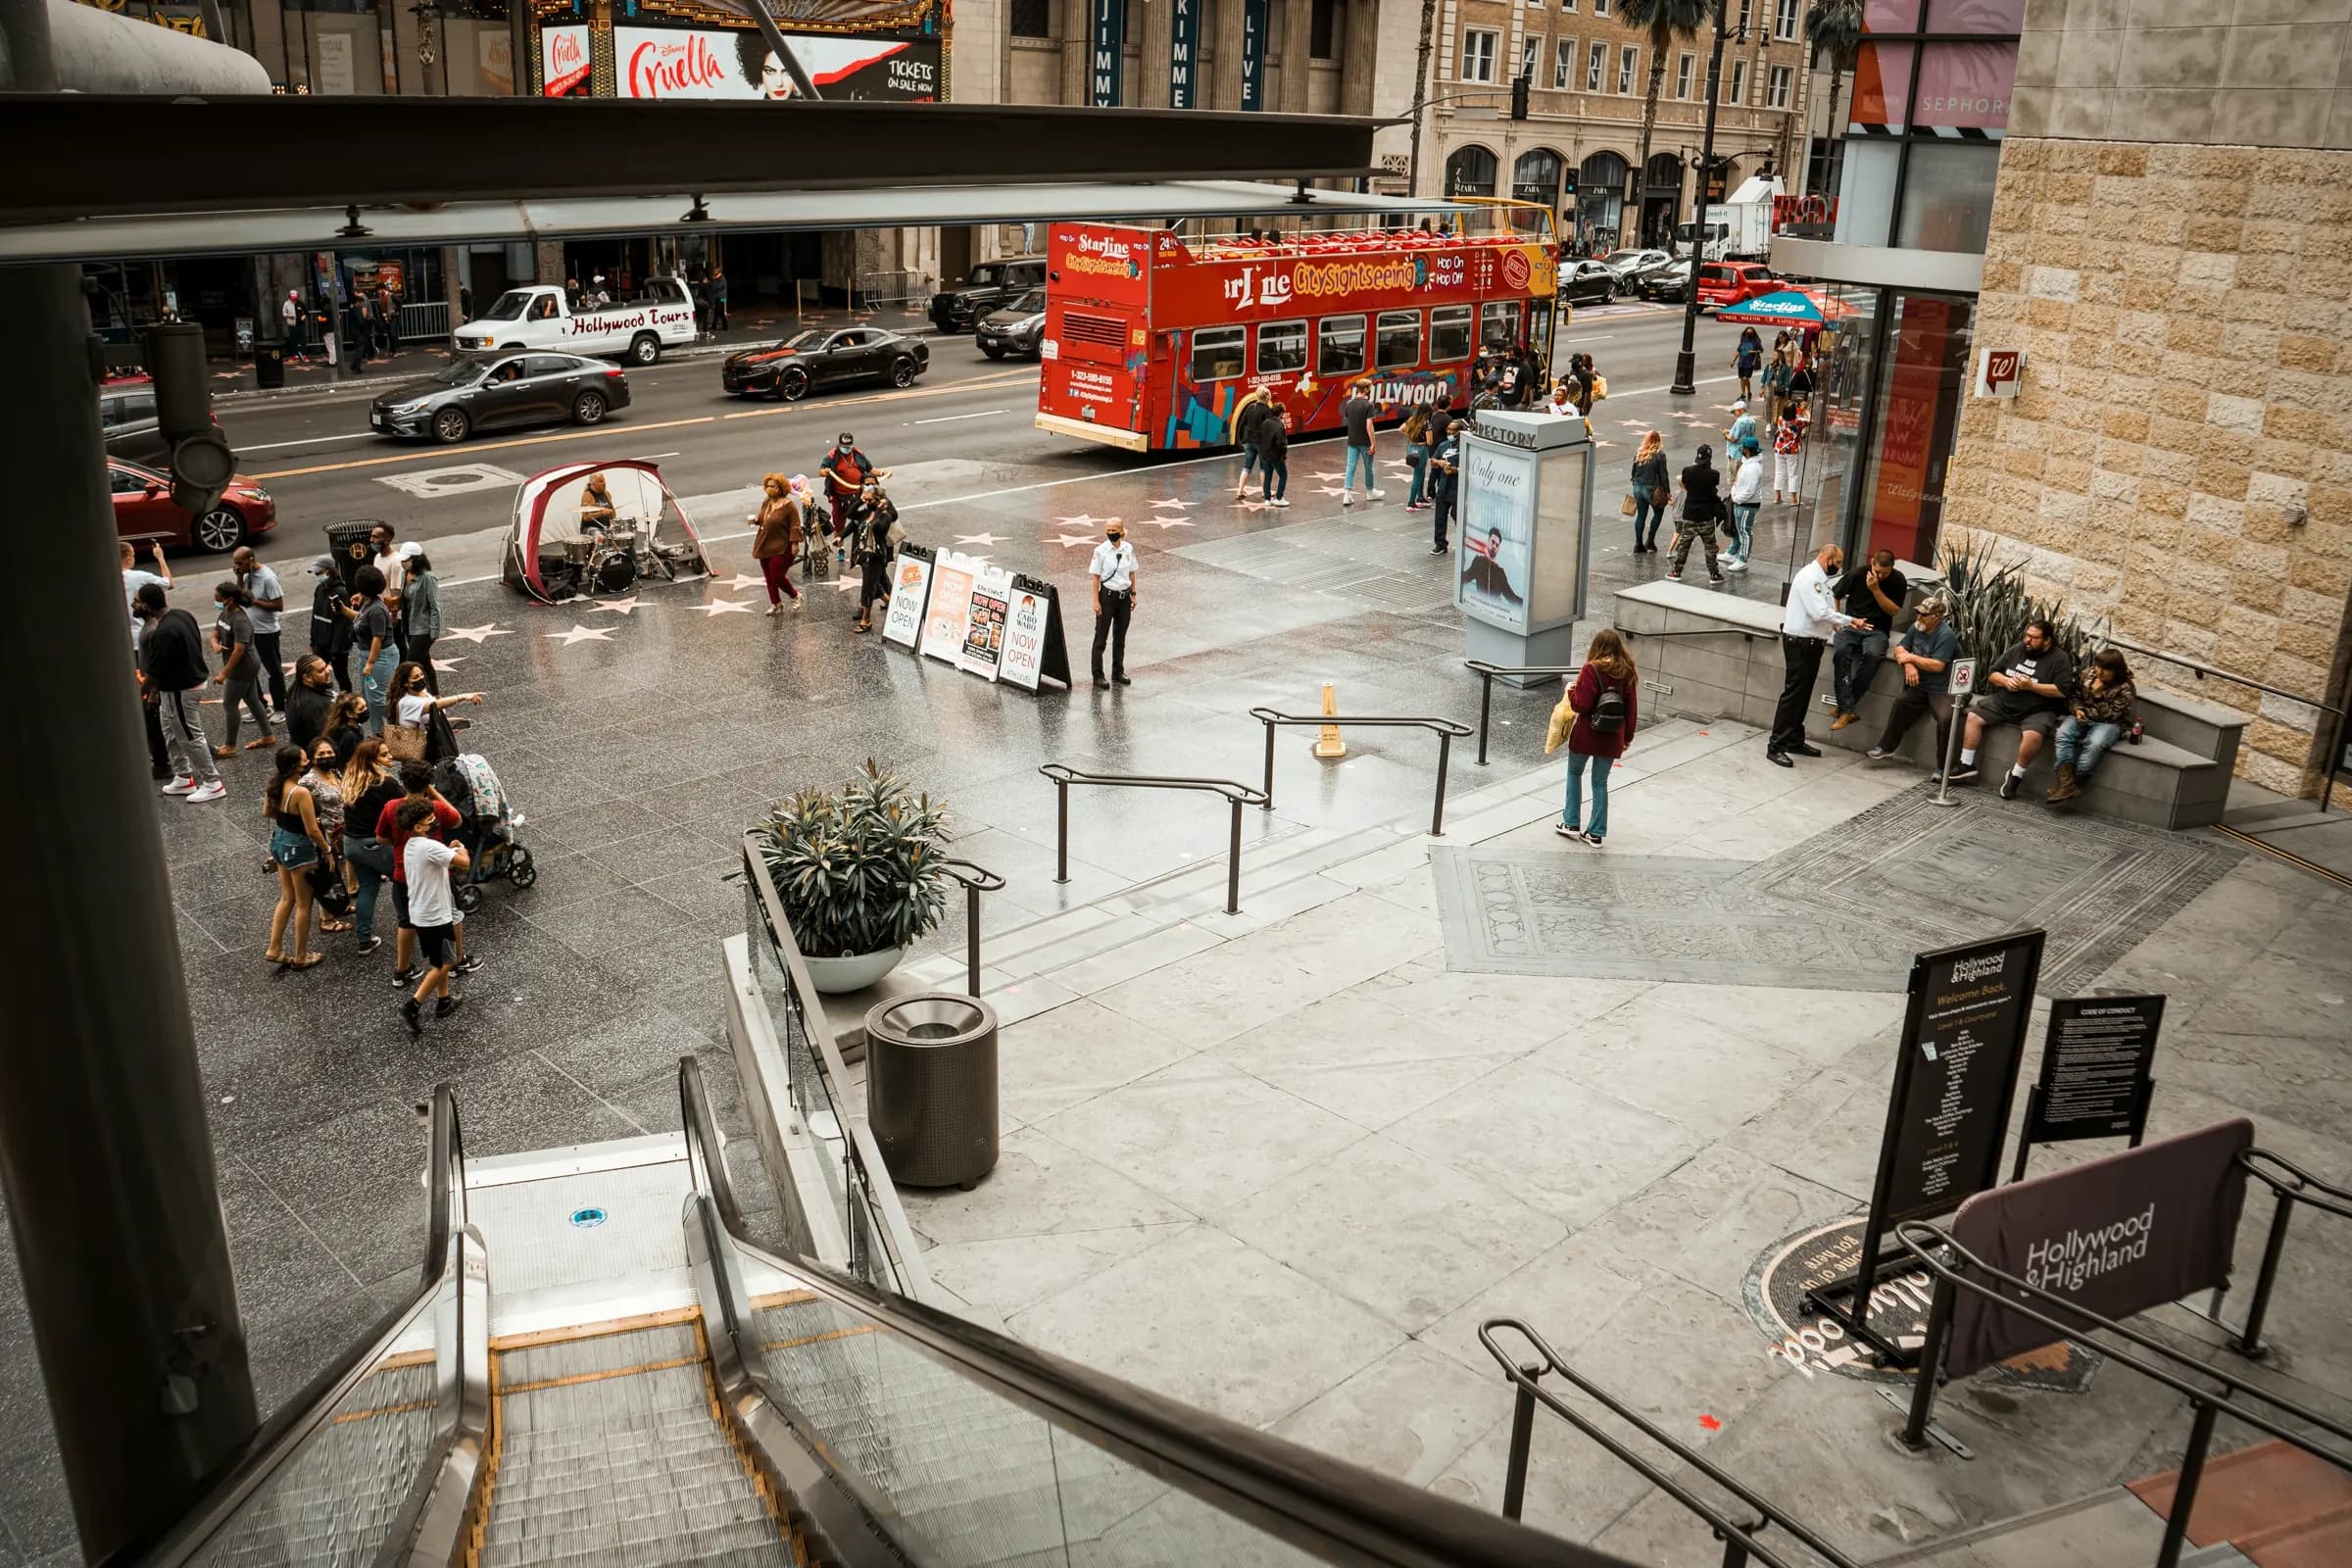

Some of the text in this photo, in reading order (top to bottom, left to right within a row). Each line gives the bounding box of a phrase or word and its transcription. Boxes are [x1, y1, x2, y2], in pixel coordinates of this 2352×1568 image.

[552, 32, 581, 74] Cruella
[1243, 16, 1254, 99] LIVE
[628, 33, 725, 99] Cruella
[889, 60, 934, 80] TICKETS
[888, 76, 933, 93] ON SALE NOW
[1460, 184, 1477, 193] ZARA
[1523, 185, 1540, 194] ZARA
[1437, 255, 1464, 270] Hop On
[1294, 259, 1416, 298] CitySightseeing
[1436, 271, 1464, 286] Hop Off
[572, 309, 689, 335] Hollywood Tours
[1470, 421, 1536, 448] DIRECTORY
[1472, 456, 1521, 487] Only one
[896, 595, 917, 612] NOW
[891, 611, 914, 628] OPEN
[1016, 618, 1037, 632] WABO
[1017, 612, 1037, 624] CABO
[1011, 631, 1038, 651] NOW
[1007, 649, 1036, 669] OPEN
[1953, 951, 2006, 972] Hollywood
[2026, 1202, 2155, 1270] Hollywood
